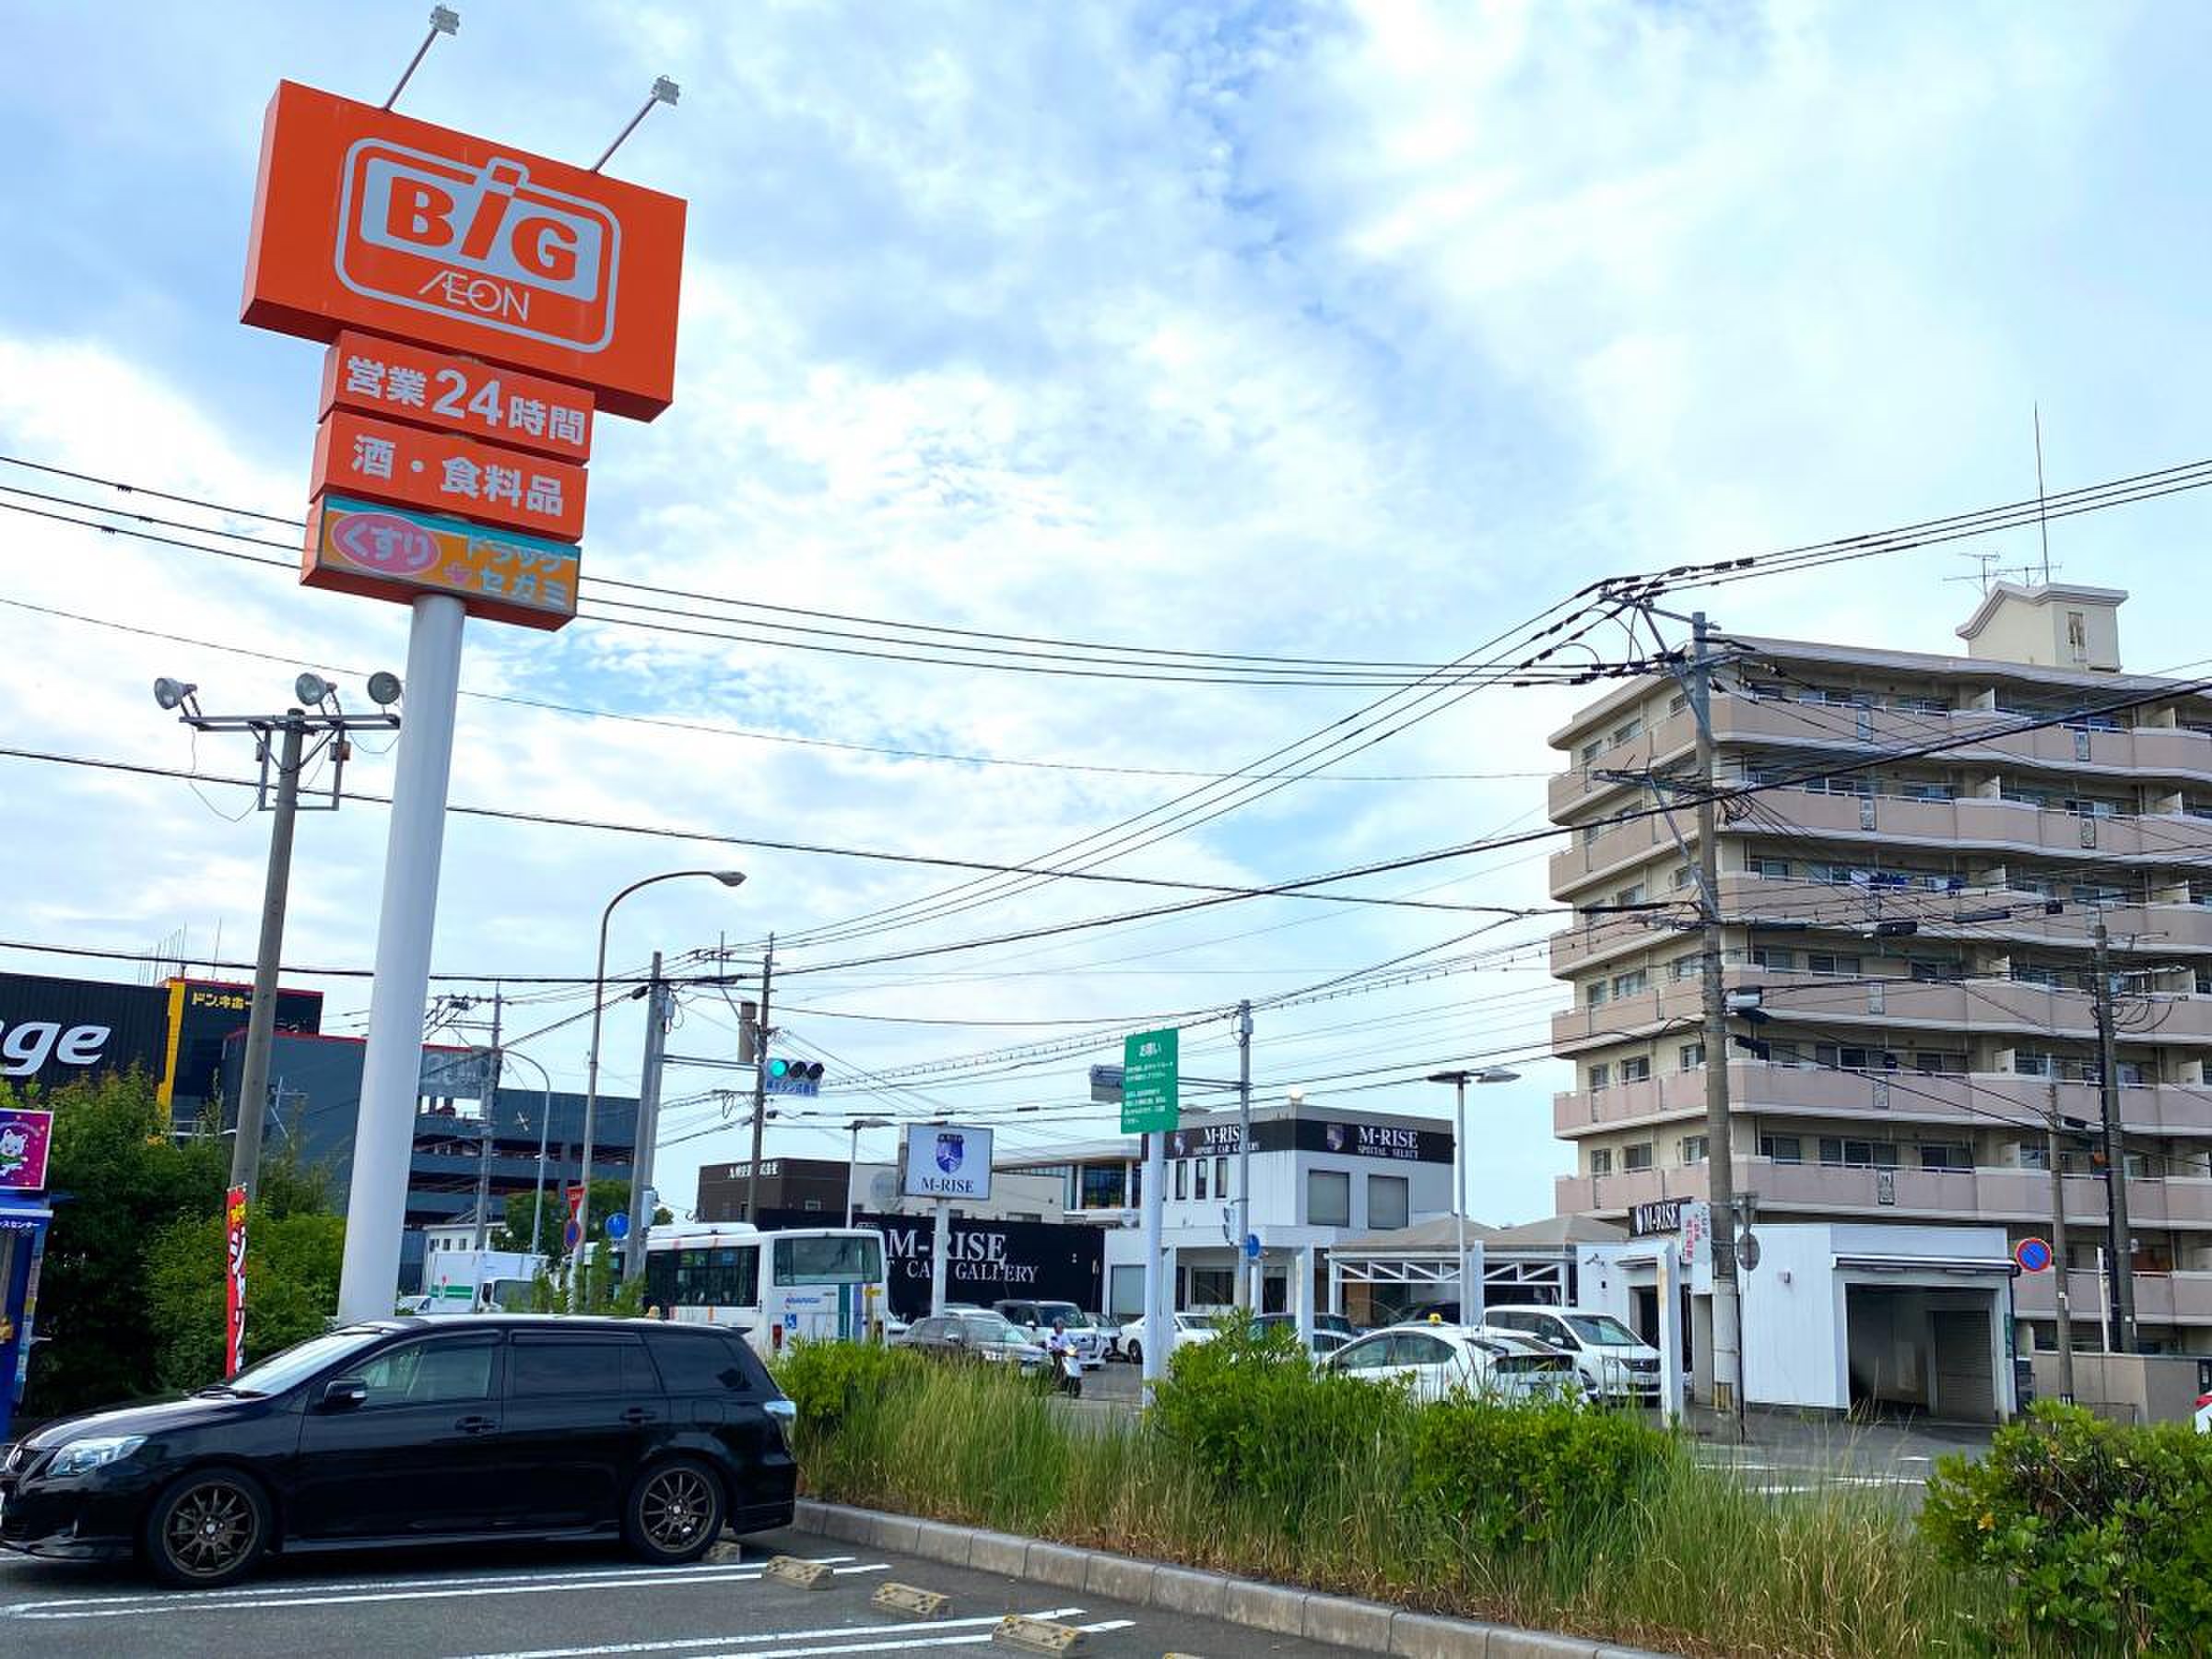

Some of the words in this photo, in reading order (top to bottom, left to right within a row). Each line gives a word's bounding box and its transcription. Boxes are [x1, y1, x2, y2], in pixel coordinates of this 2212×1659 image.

[347, 355, 586, 446] 営業24時間
[352, 433, 565, 518] 酒・食料品
[343, 522, 429, 566] くすり
[480, 566, 567, 607] セガミ
[0, 1020, 112, 1076] ge
[1203, 1125, 1240, 1145] M-RIS
[1359, 1125, 1418, 1149] M-RISE
[922, 1177, 974, 1194] M-RISE
[906, 1259, 931, 1278] CA
[955, 1260, 1039, 1283] GALLERY
